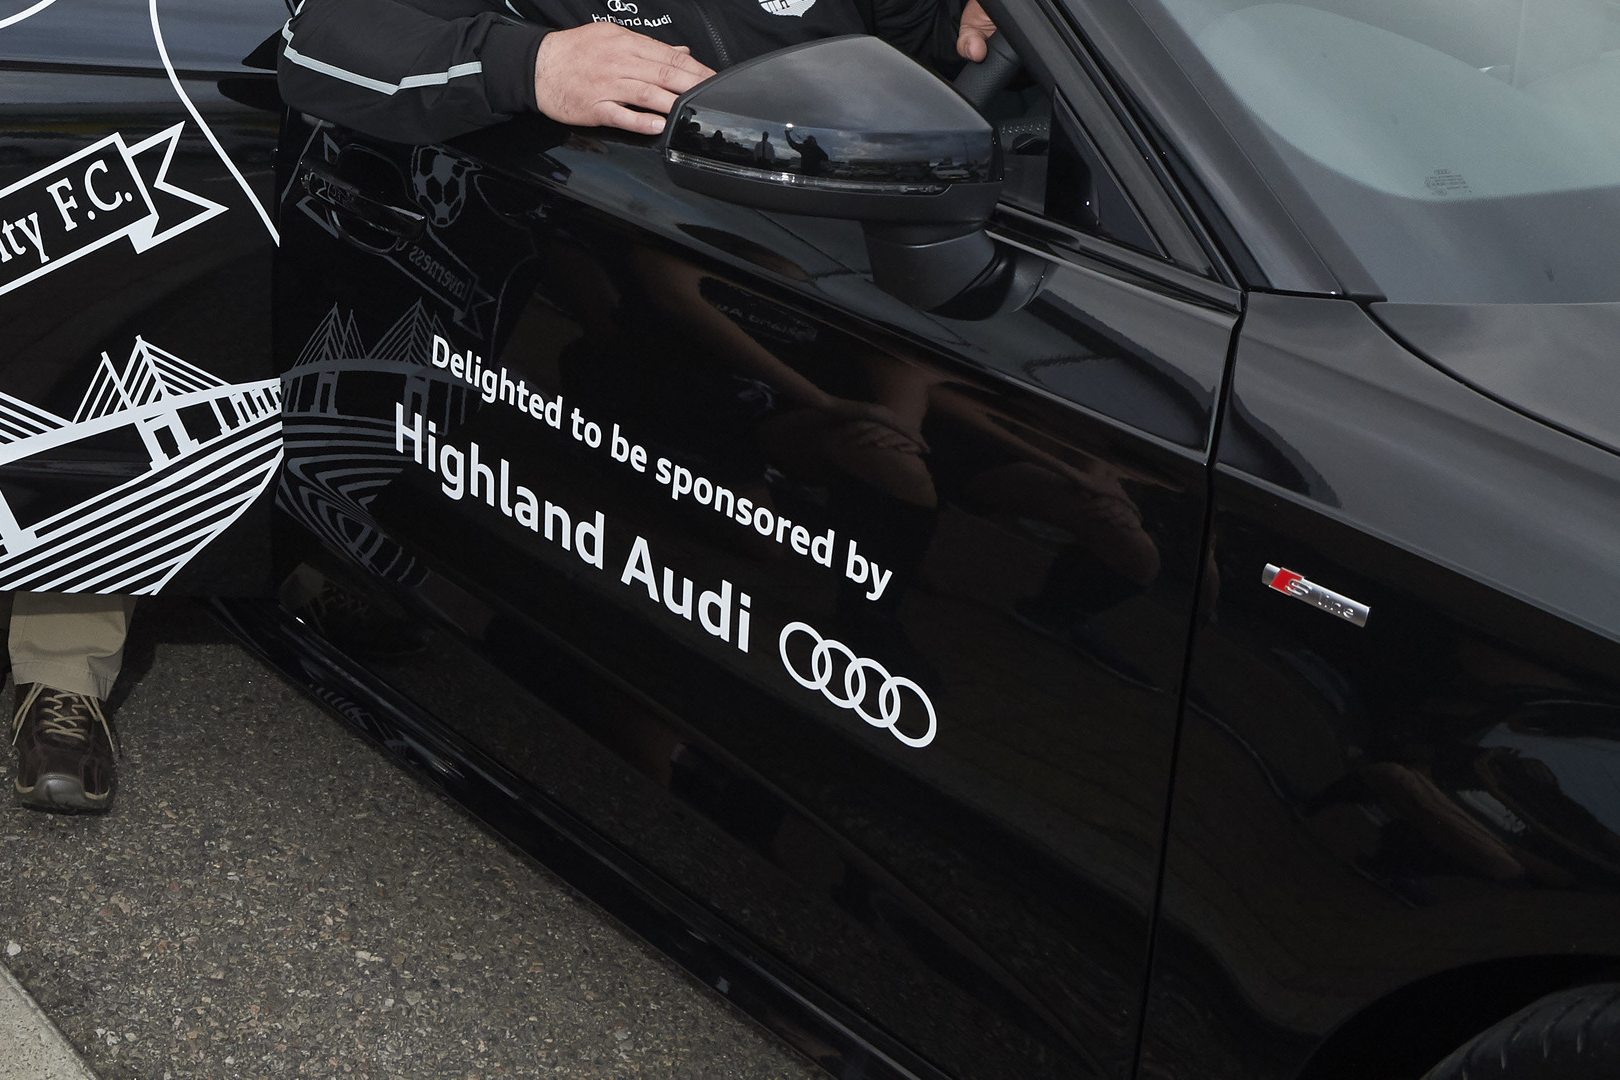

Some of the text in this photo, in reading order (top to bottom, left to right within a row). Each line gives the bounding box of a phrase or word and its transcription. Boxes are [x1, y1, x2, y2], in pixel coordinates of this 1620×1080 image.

[644, 14, 673, 27] Audi
[46, 159, 134, 233] F.C.
[394, 401, 752, 654] Highland Audi
[431, 334, 893, 602] Delighted to be sponsored by
